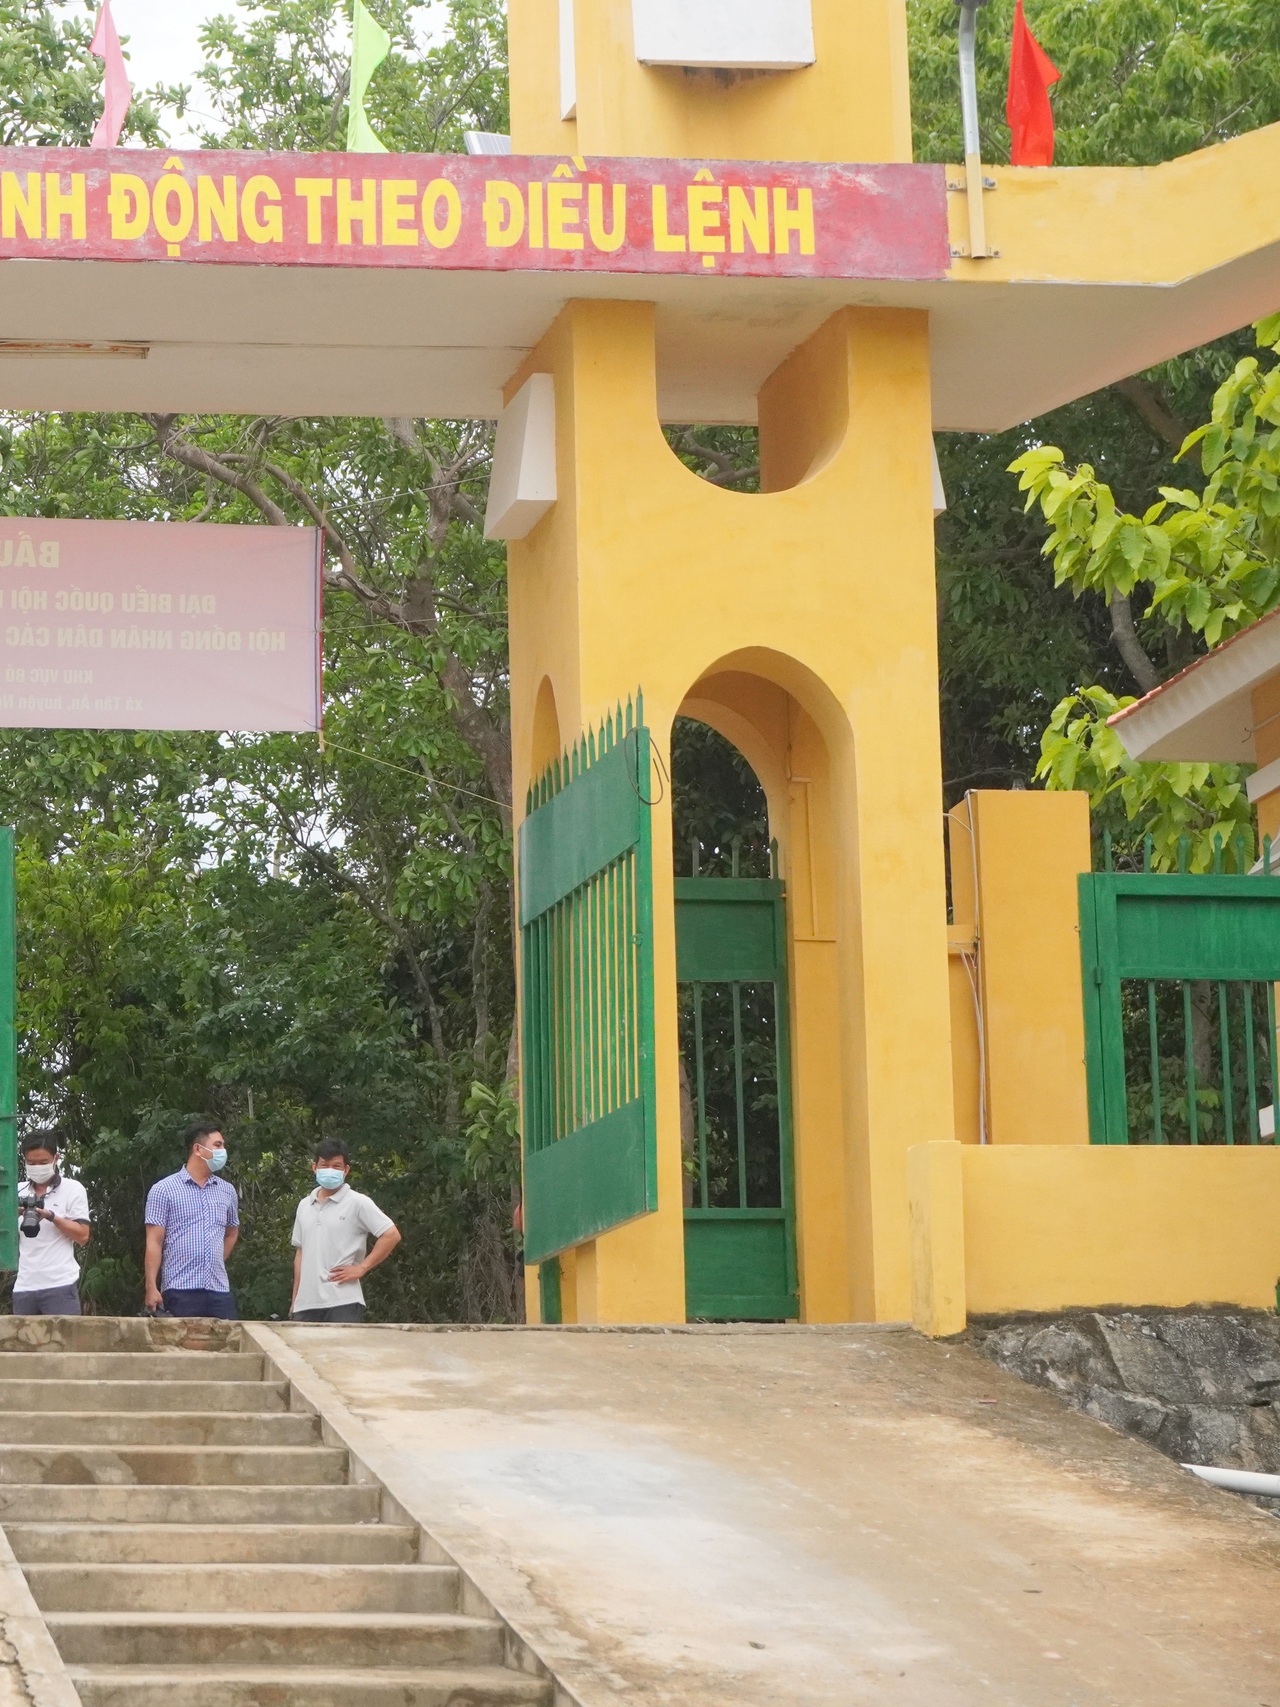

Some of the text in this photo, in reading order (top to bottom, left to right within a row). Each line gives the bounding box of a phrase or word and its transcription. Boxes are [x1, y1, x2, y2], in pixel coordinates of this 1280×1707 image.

[107, 154, 283, 257] ĐỘNG
[295, 178, 463, 250] THEO
[482, 157, 626, 253] ĐIỀU
[652, 167, 816, 268] LỆNH
